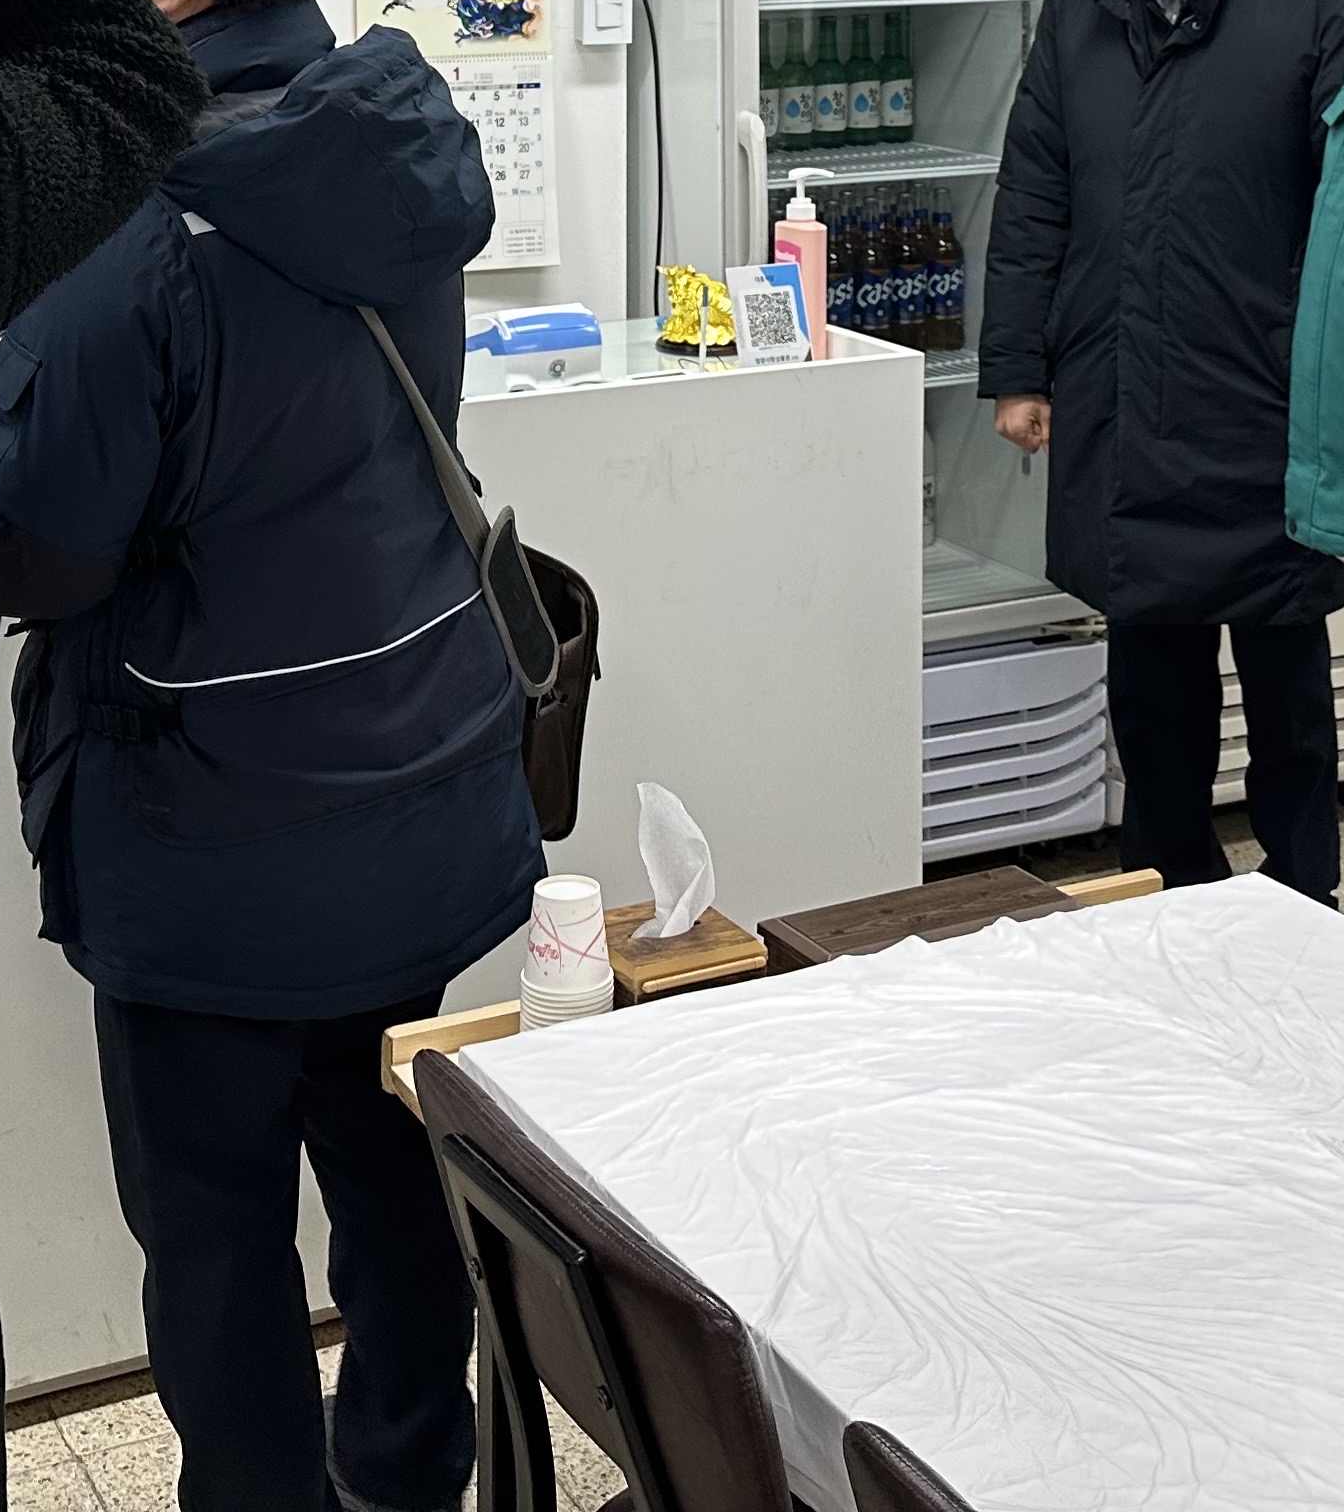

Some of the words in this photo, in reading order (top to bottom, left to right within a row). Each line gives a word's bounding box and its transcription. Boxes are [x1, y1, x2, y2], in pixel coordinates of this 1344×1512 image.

[469, 92, 476, 102] 4
[493, 91, 501, 101] 5
[494, 117, 505, 128] 12
[518, 116, 529, 127] 13
[494, 144, 506, 155] 19
[518, 143, 530, 154] 20
[494, 170, 507, 181] 26
[519, 169, 531, 180] 27
